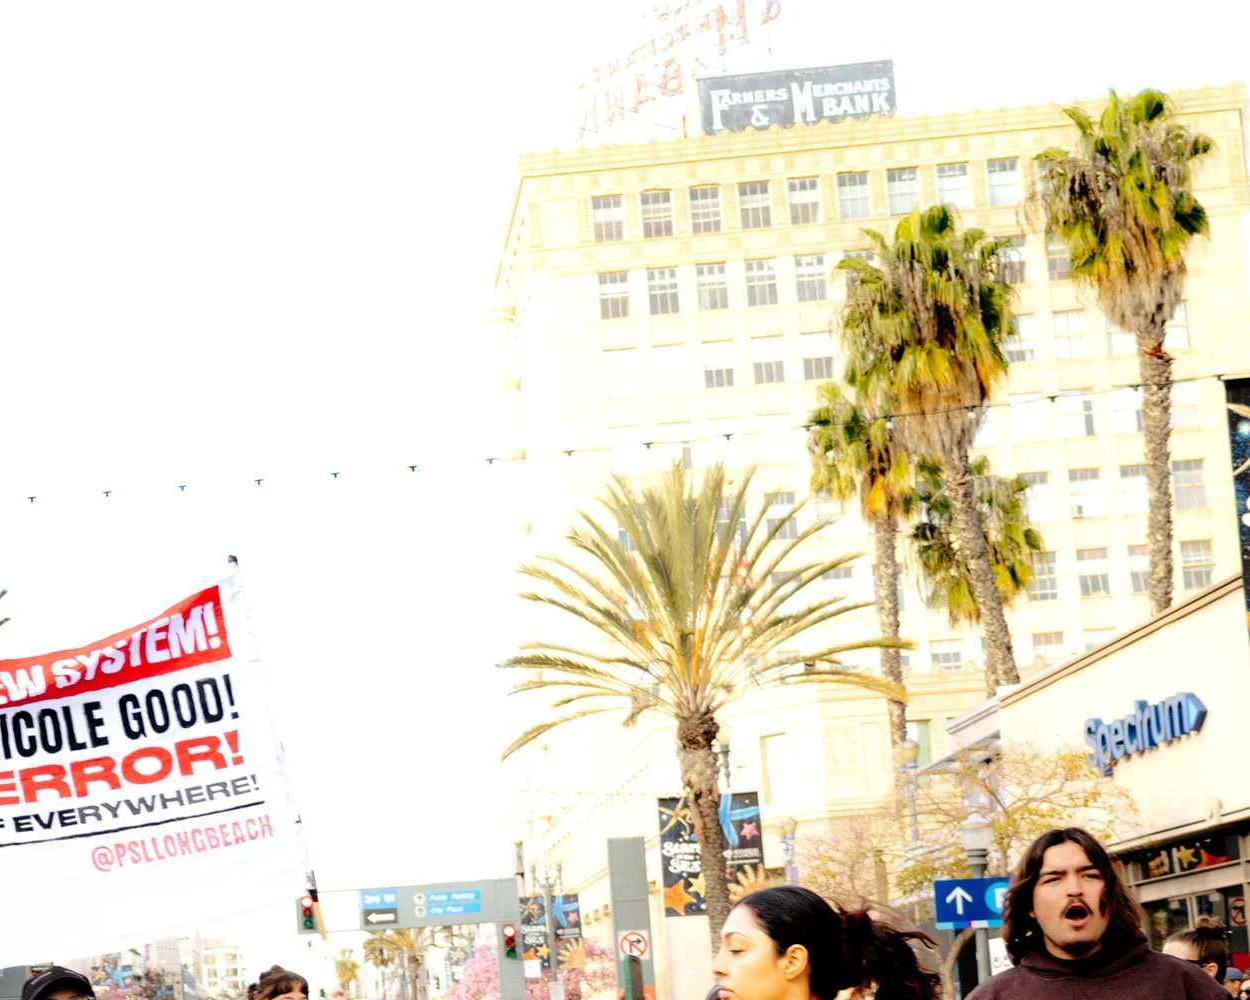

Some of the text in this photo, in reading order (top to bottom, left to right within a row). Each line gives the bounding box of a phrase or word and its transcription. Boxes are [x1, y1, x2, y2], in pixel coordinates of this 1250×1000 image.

[710, 88, 788, 130] FARMERS
[790, 78, 890, 122] MERCHANTS
[750, 92, 891, 127] & BANK
[51, 601, 222, 689] SYSTEM!
[118, 674, 239, 741] GOOD!
[1084, 692, 1190, 777] Spectrum
[12, 774, 260, 833] EVERYWHERE!
[91, 814, 275, 872] @PSLLONGBEACH
